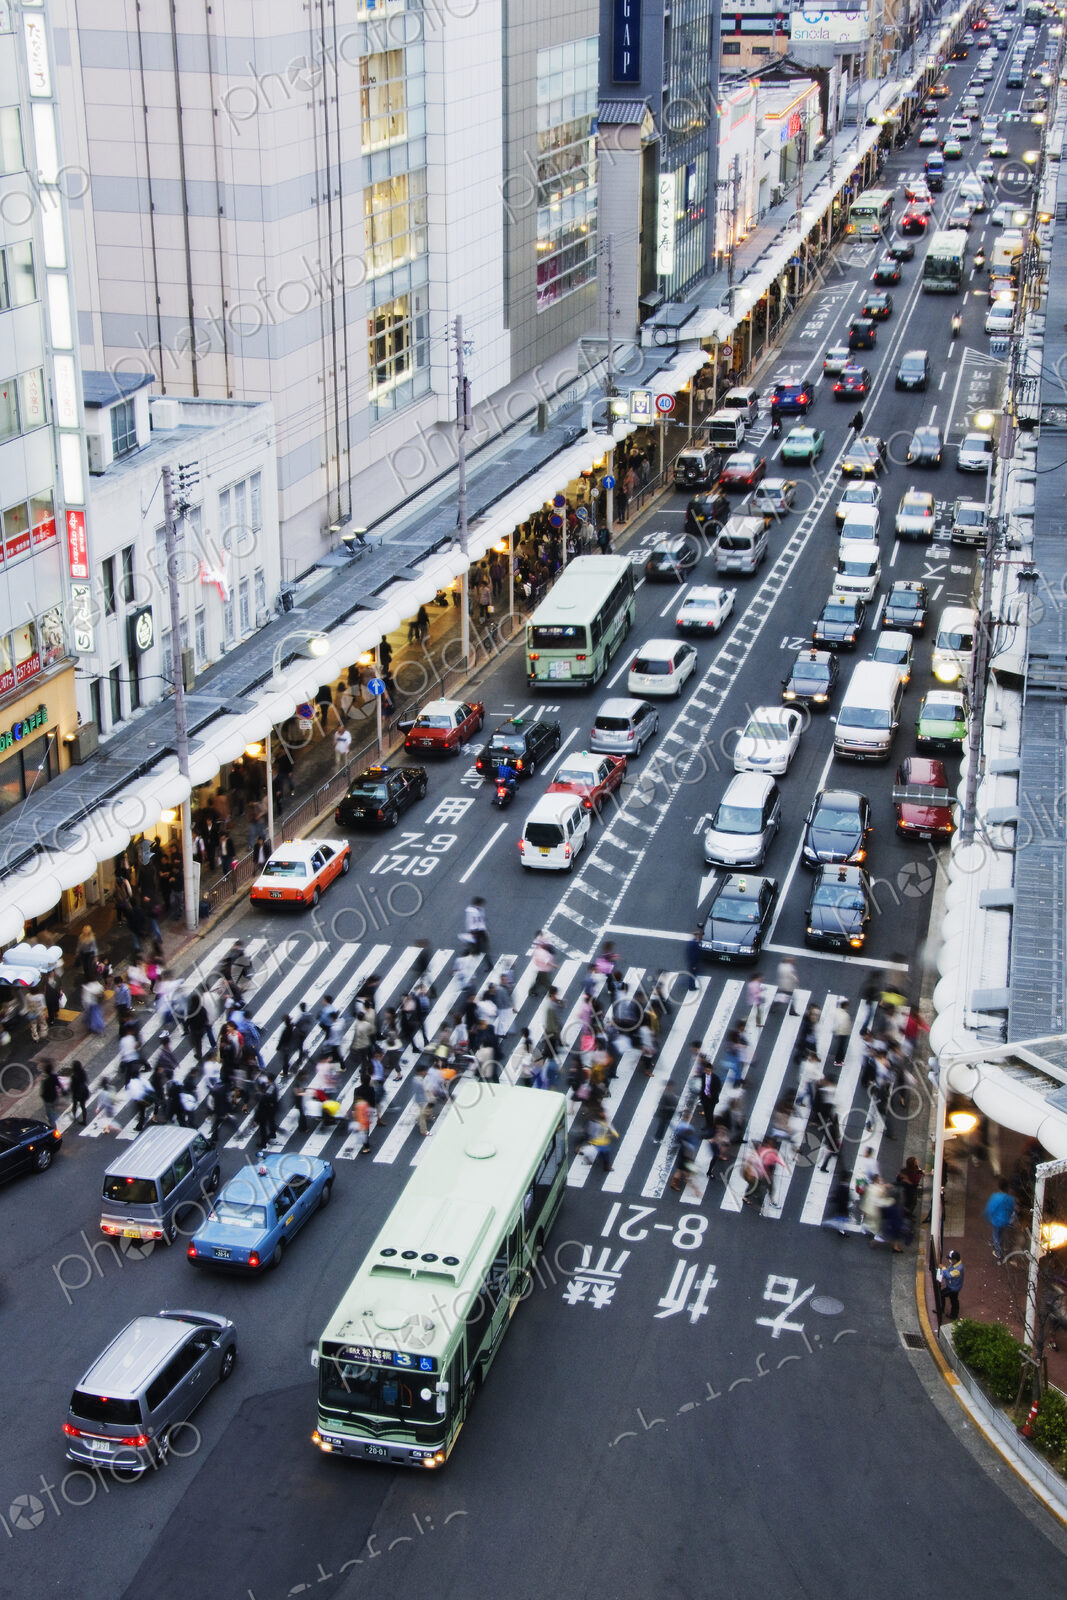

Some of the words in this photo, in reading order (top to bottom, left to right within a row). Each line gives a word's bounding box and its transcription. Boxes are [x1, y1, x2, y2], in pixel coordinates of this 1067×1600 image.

[623, 0, 632, 74] GAP
[659, 398, 671, 408] 40
[390, 832, 458, 853] 7-9
[370, 854, 441, 877] 17-19
[600, 1202, 709, 1250] 8-21
[397, 1353, 411, 1366] 3
[368, 1446, 387, 1456] 20-01
